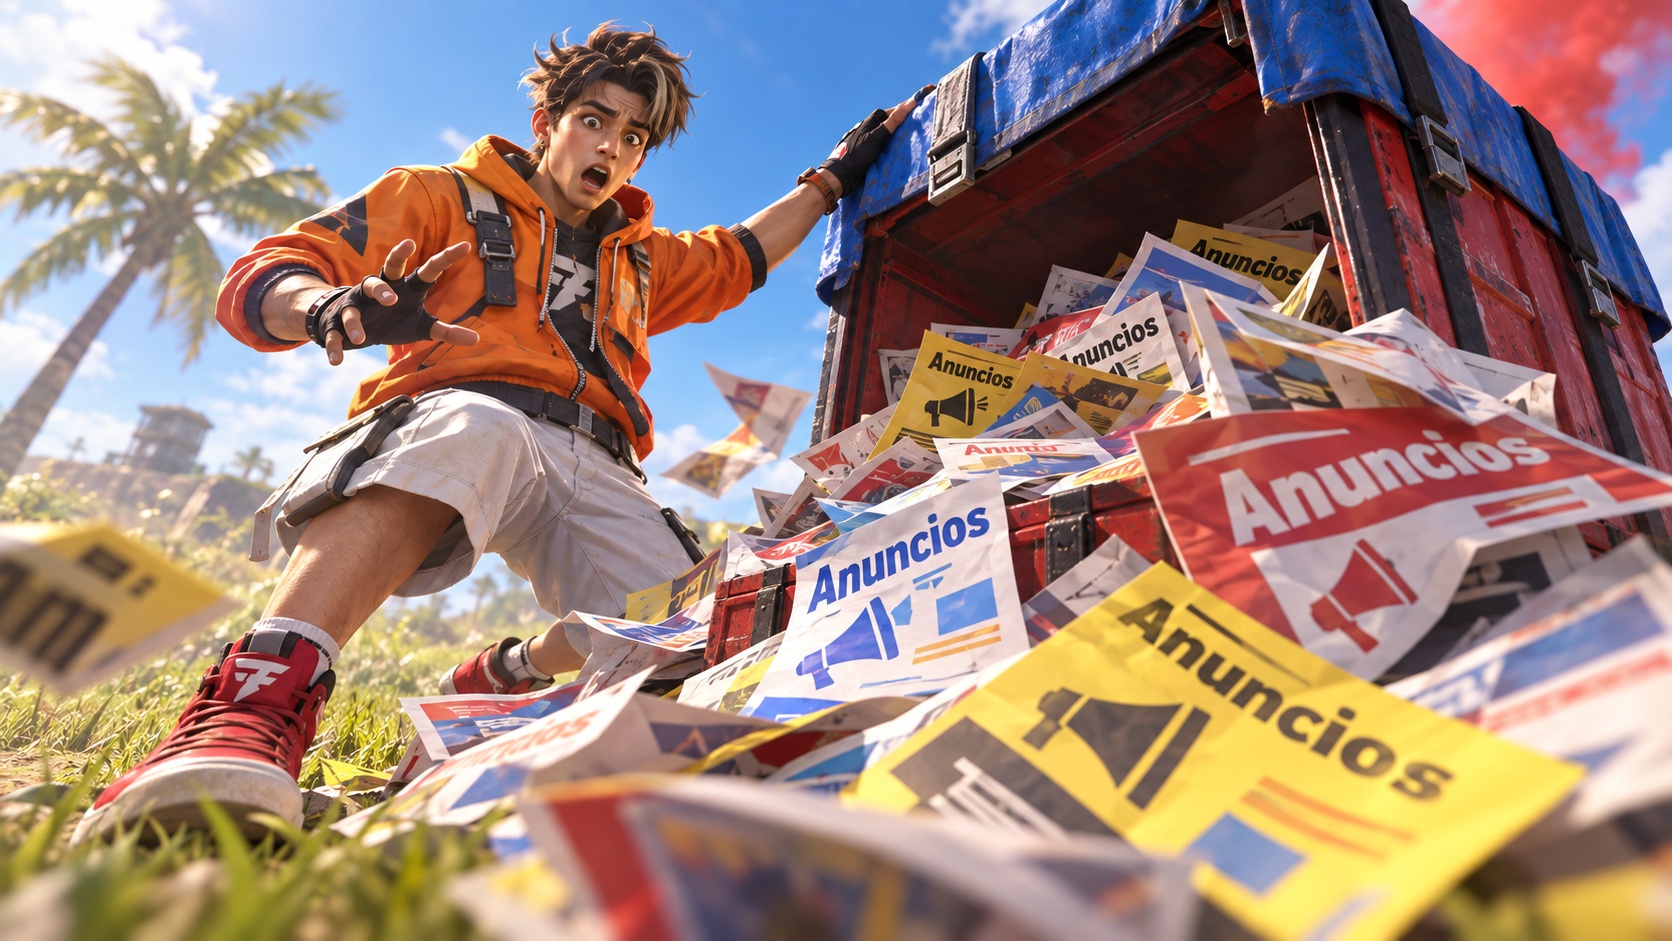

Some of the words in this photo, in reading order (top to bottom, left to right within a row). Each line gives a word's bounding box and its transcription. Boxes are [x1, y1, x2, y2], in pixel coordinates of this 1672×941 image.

[1189, 237, 1304, 286] Anuncios
[927, 351, 1014, 389] Anuncios
[1219, 430, 1551, 547] Anuncios
[807, 507, 990, 614] Anuncios
[1117, 597, 1455, 802] Anuncios
